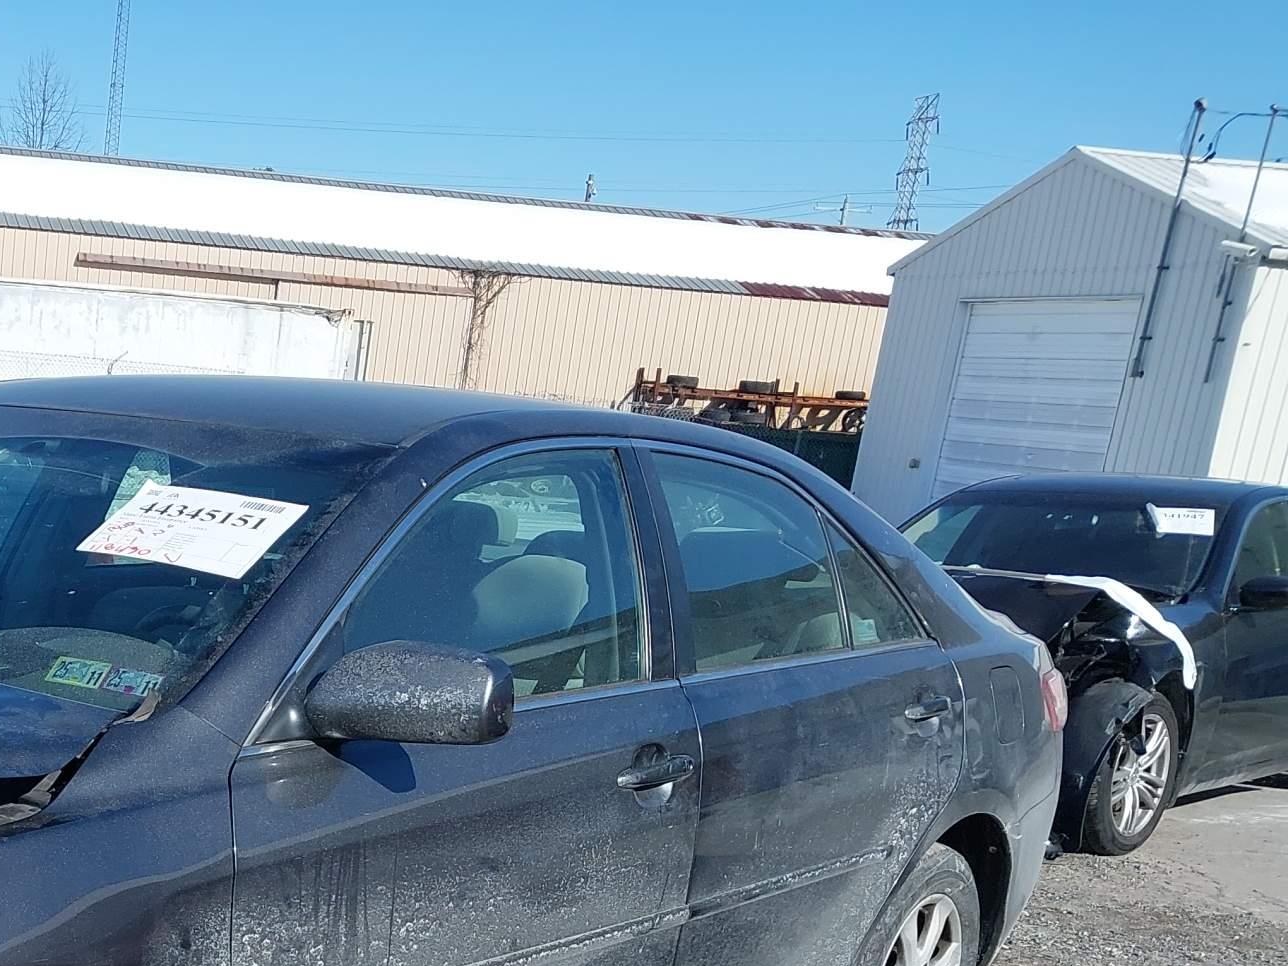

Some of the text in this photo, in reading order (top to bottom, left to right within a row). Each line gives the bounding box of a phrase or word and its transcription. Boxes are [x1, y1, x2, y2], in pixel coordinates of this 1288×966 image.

[139, 502, 268, 530] 44345151
[52, 660, 104, 687] 25 11
[106, 669, 127, 688] 25
